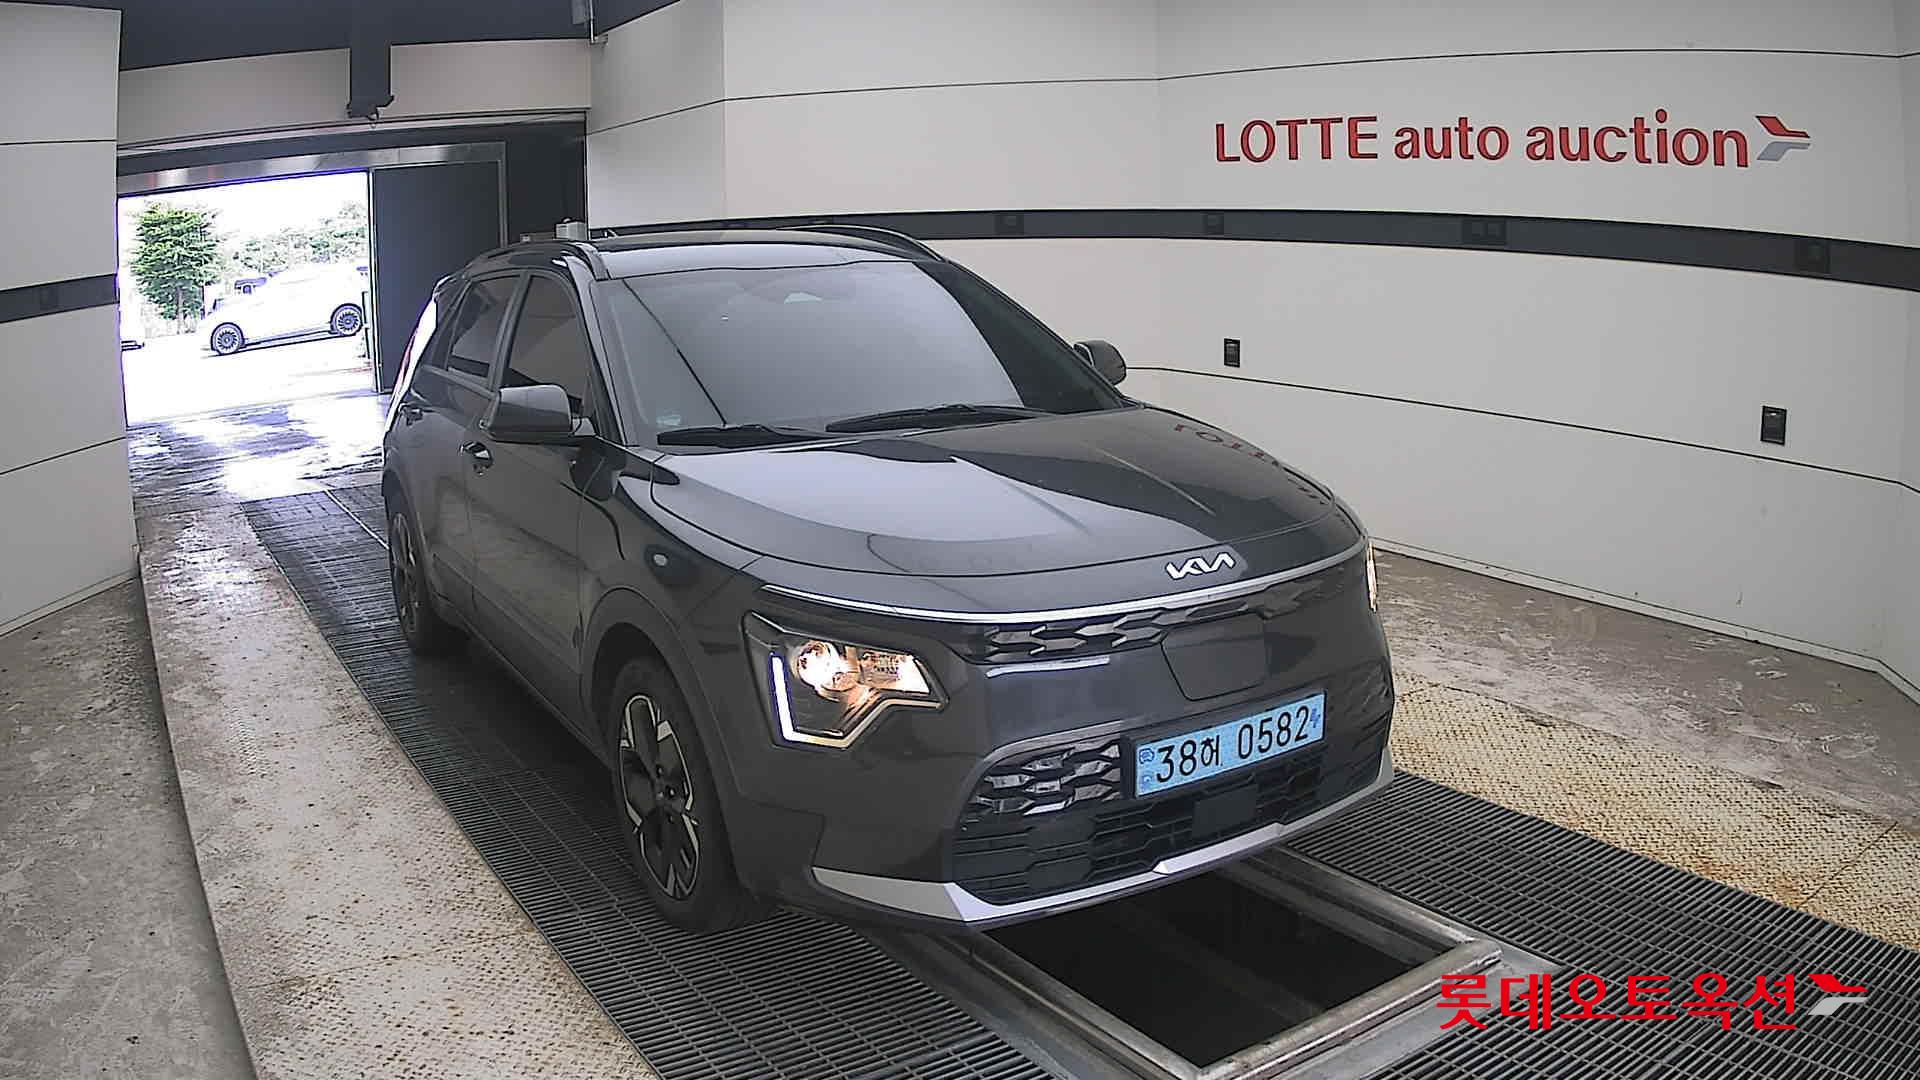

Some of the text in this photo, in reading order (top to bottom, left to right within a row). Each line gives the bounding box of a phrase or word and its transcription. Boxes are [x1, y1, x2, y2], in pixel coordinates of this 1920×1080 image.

[1215, 109, 1750, 168] LOTTE auto auction
[1156, 706, 1310, 783] 38허 0582
